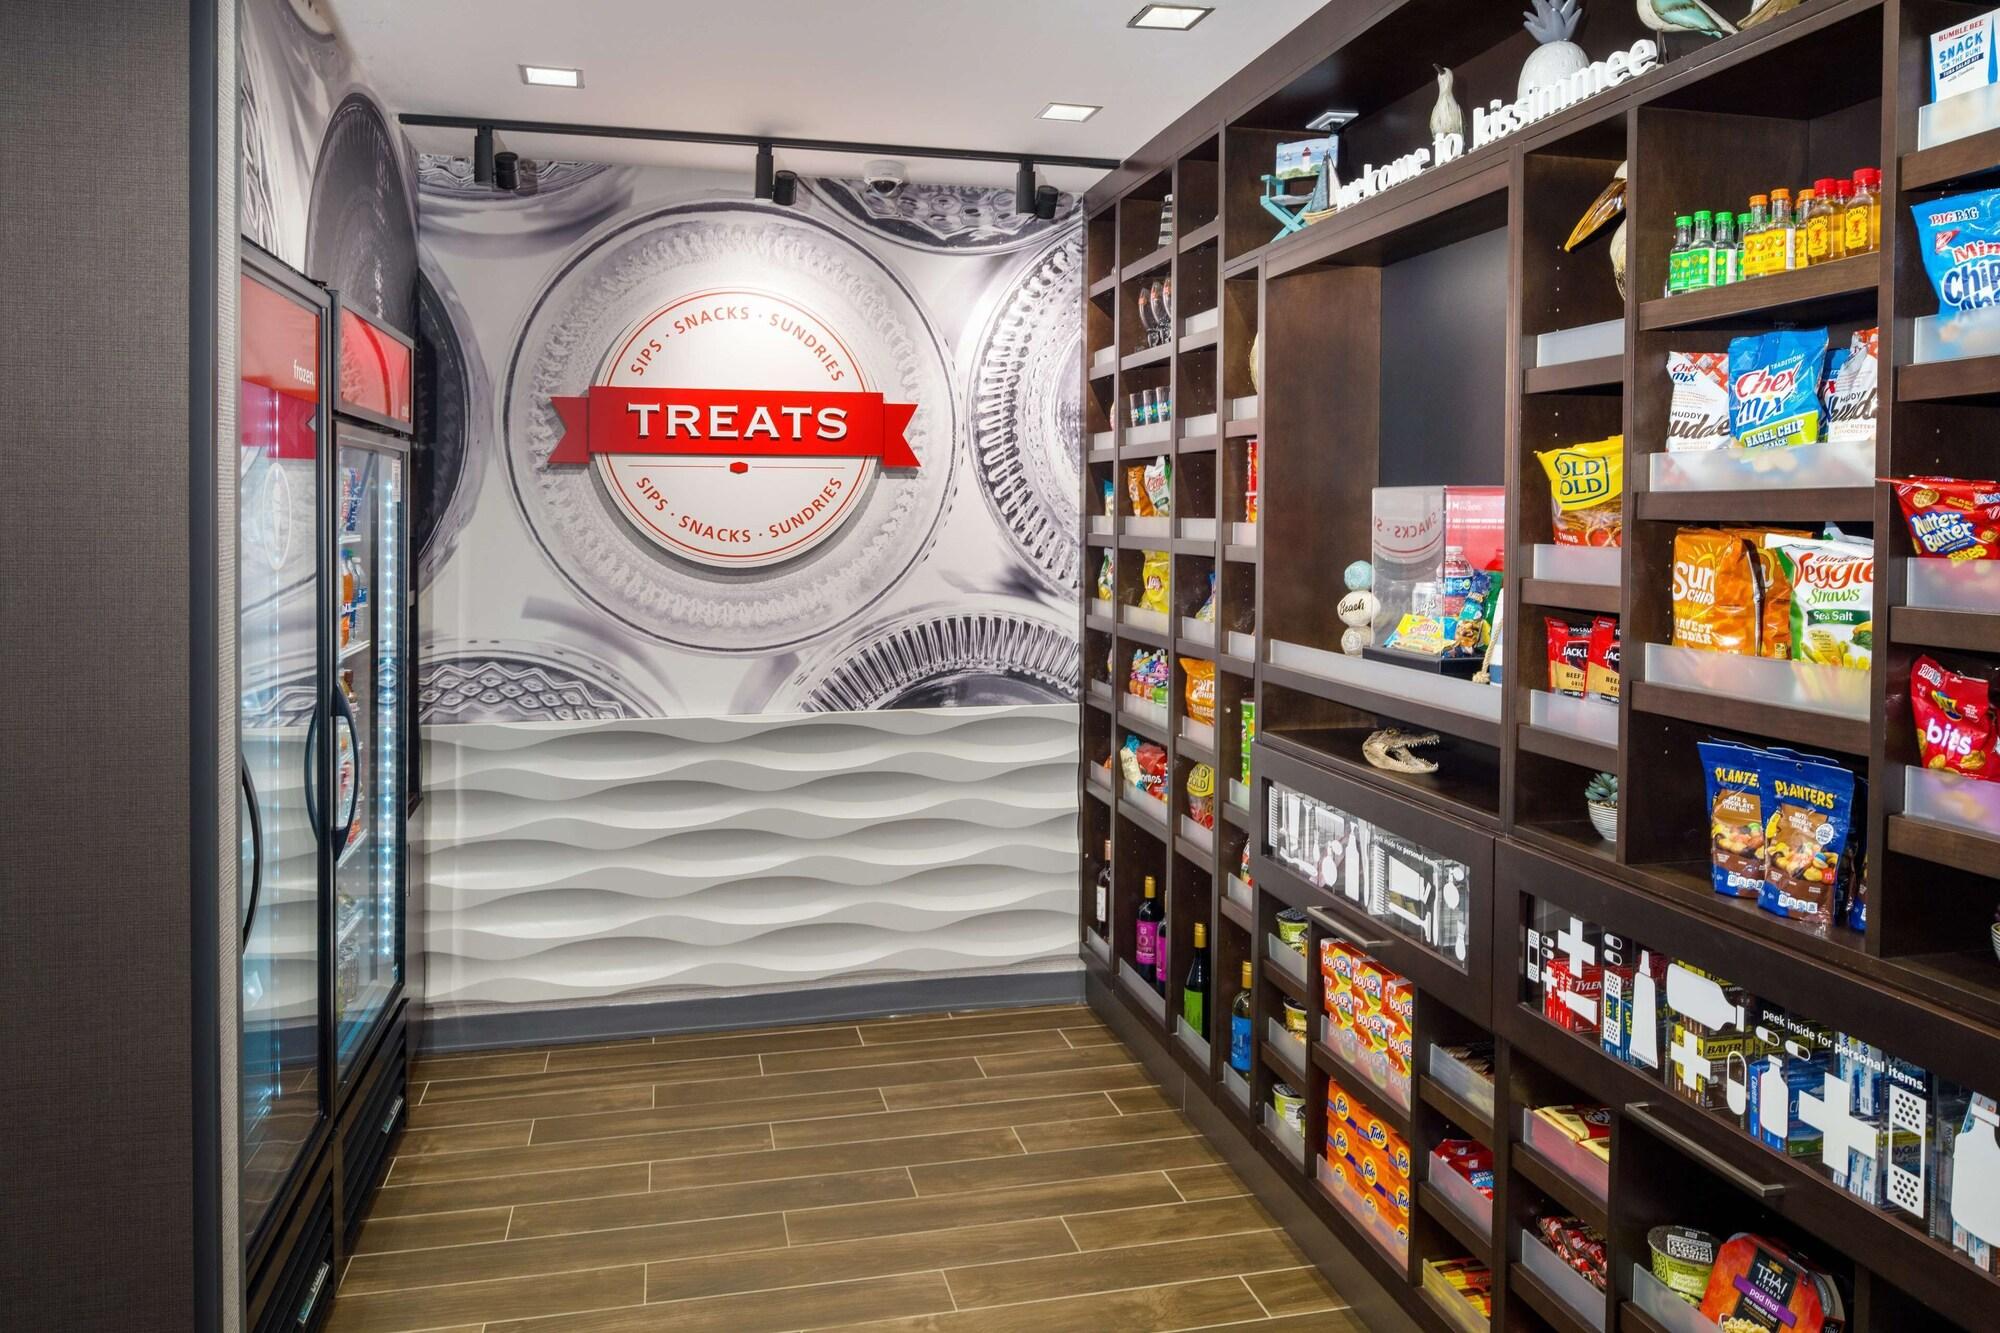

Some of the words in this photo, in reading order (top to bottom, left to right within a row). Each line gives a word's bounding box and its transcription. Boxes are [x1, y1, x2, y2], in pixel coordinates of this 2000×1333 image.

[1970, 19, 1984, 30] BEE
[1939, 31, 1983, 64] SNACK
[1432, 133, 1464, 168] to
[1472, 39, 1658, 151] kissimmee
[1931, 212, 1953, 225] BIG
[1955, 207, 1978, 221] BAG
[631, 339, 663, 376] SIPS
[674, 306, 750, 336] SNACKS
[769, 313, 845, 382] SUNDRIES
[1736, 362, 1802, 398] Chex
[628, 402, 849, 439] TREATS
[1671, 411, 1702, 419] MUDDY
[1745, 429, 1777, 447] BAGEL
[1778, 420, 1805, 436] CHIP
[636, 476, 669, 513] SIPS
[678, 515, 751, 543] SNACKS
[769, 477, 842, 539] SUNDRIES
[1911, 513, 1960, 537] Nutter
[1922, 522, 1973, 552] Butter
[1673, 561, 1715, 601] Sun
[1785, 552, 1873, 590] Veggie
[1807, 588, 1860, 605] Straws
[1339, 599, 1365, 616] Beach
[1813, 611, 1830, 621] Sea
[1832, 611, 1853, 621] Salt
[1562, 647, 1583, 658] JACK
[1927, 718, 1972, 755] bits
[1715, 767, 1760, 788] PLANTE
[1775, 780, 1834, 809] PLANTERS
[1403, 847, 1423, 861] personal
[1323, 952, 1346, 972] bounce
[1354, 972, 1377, 992] bounce
[1327, 991, 1348, 1008] bounce
[1357, 1012, 1381, 1032] bounce
[1707, 1042, 1742, 1054] BAYER
[1763, 1010, 1785, 1028] peek
[1787, 1020, 1815, 1040] inside
[1817, 1033, 1833, 1049] for
[1834, 1043, 1885, 1073] personal
[1888, 1065, 1927, 1092] items.
[1337, 1098, 1347, 1112] Tide
[1336, 1134, 1347, 1148] Tide
[1370, 1126, 1386, 1141] Tide
[1364, 1162, 1376, 1177] Tide
[1398, 1153, 1409, 1169] Tide
[1757, 1263, 1788, 1294] THAI
[1750, 1288, 1765, 1302] pad
[1765, 1298, 1779, 1312] thai
